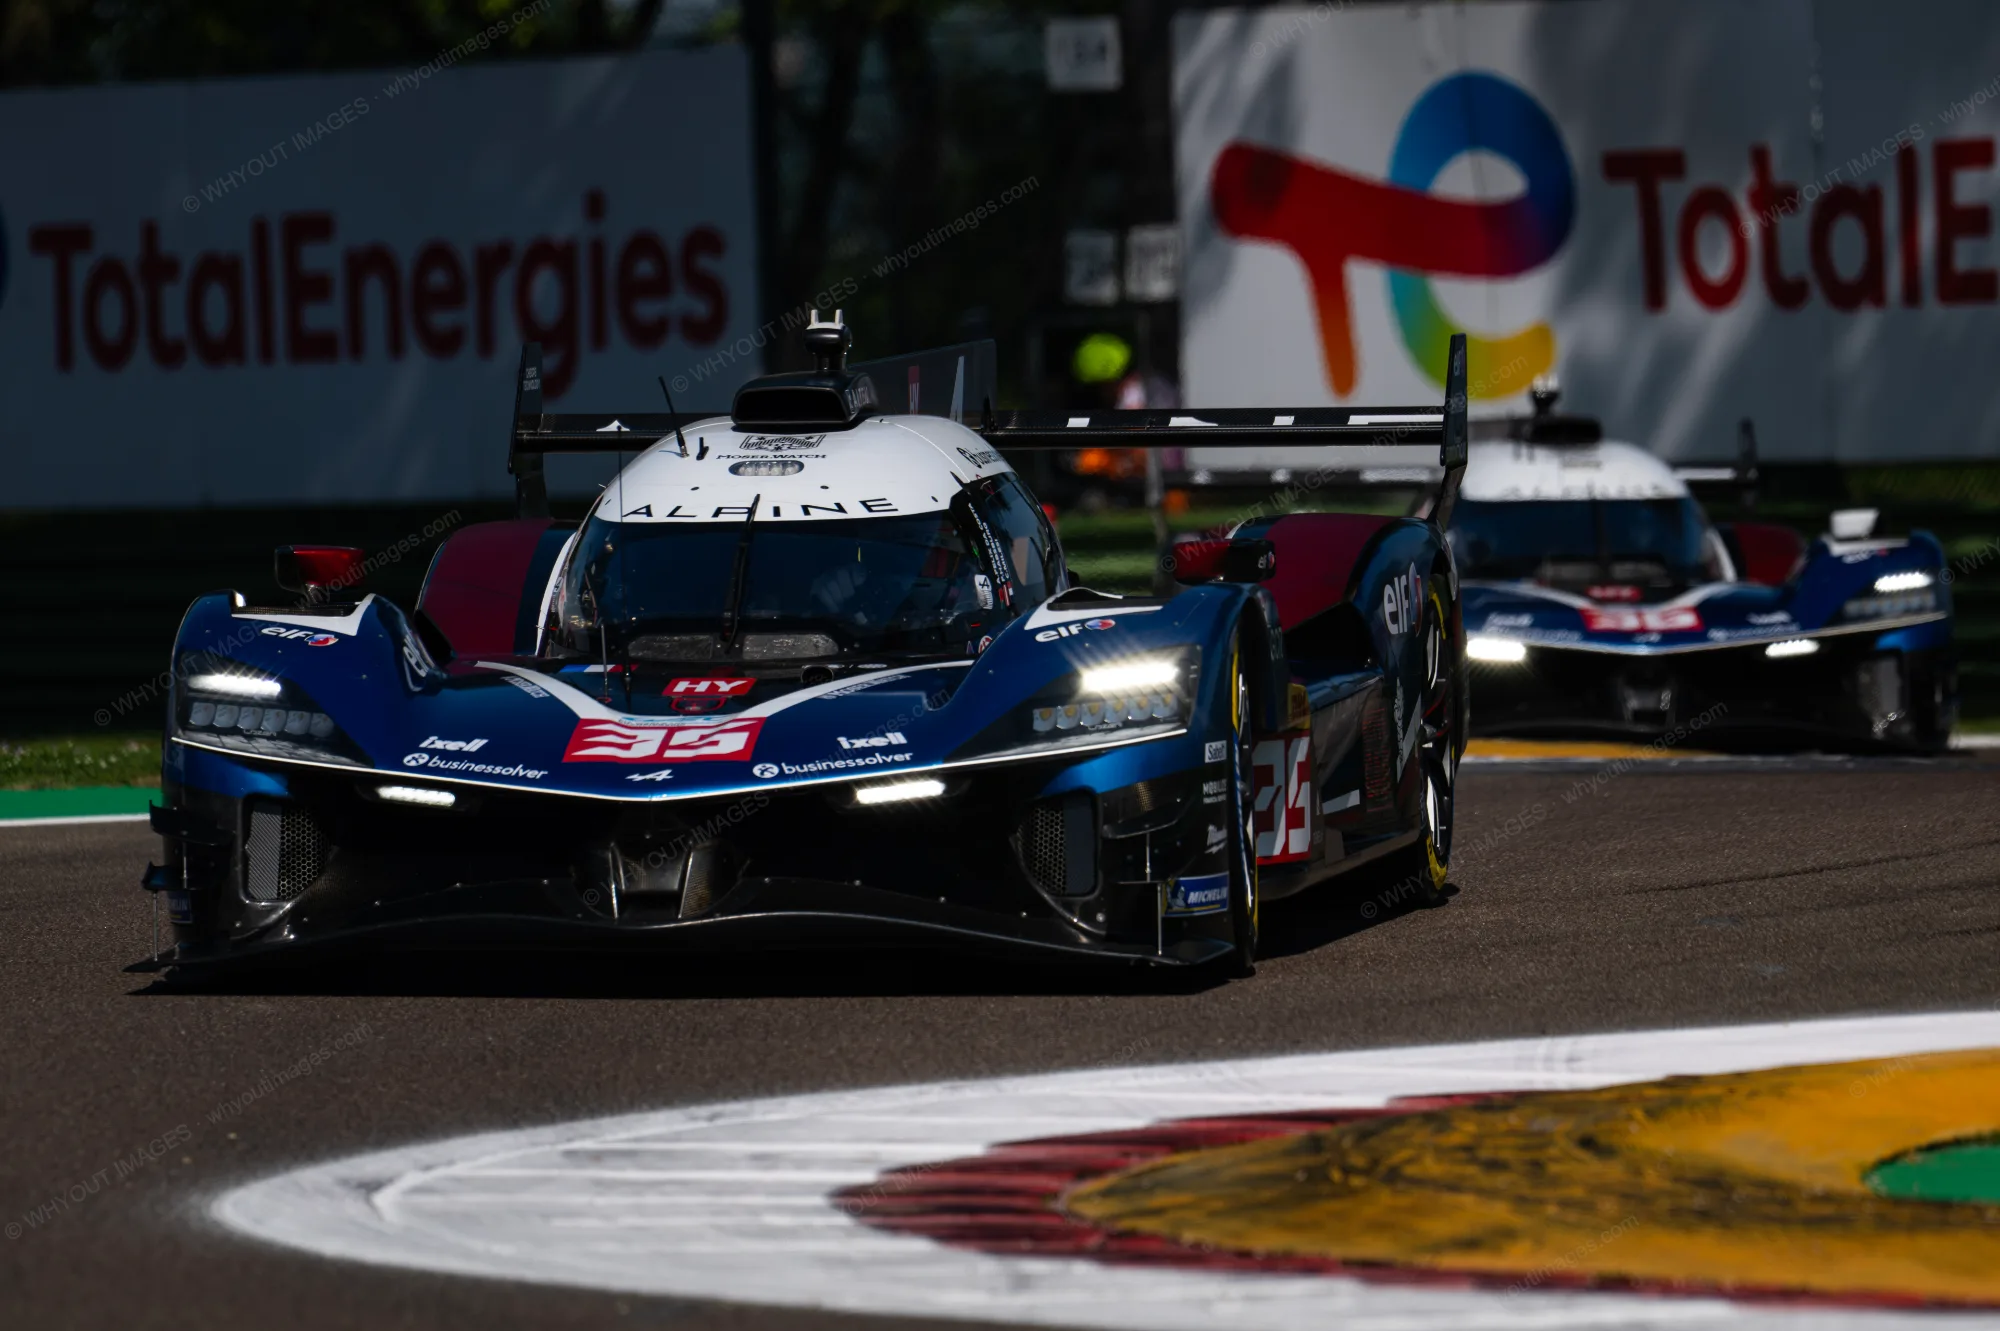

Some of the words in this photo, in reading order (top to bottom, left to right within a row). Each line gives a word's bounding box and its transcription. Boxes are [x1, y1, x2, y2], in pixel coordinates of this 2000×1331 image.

[1603, 137, 1998, 310] TotalE
[30, 190, 729, 400] TotalEnergies
[622, 498, 899, 518] ALPINE
[1383, 574, 1410, 635] elf
[261, 626, 314, 640] elf
[1034, 623, 1084, 643] elf
[673, 680, 748, 693] HY
[419, 736, 489, 752] ixell
[571, 720, 759, 759] 35
[837, 732, 908, 750] ixell
[427, 755, 549, 779] businessolver
[781, 752, 913, 775] businessolver
[1252, 737, 1311, 857] 35
[1187, 887, 1228, 904] MICHELIN
